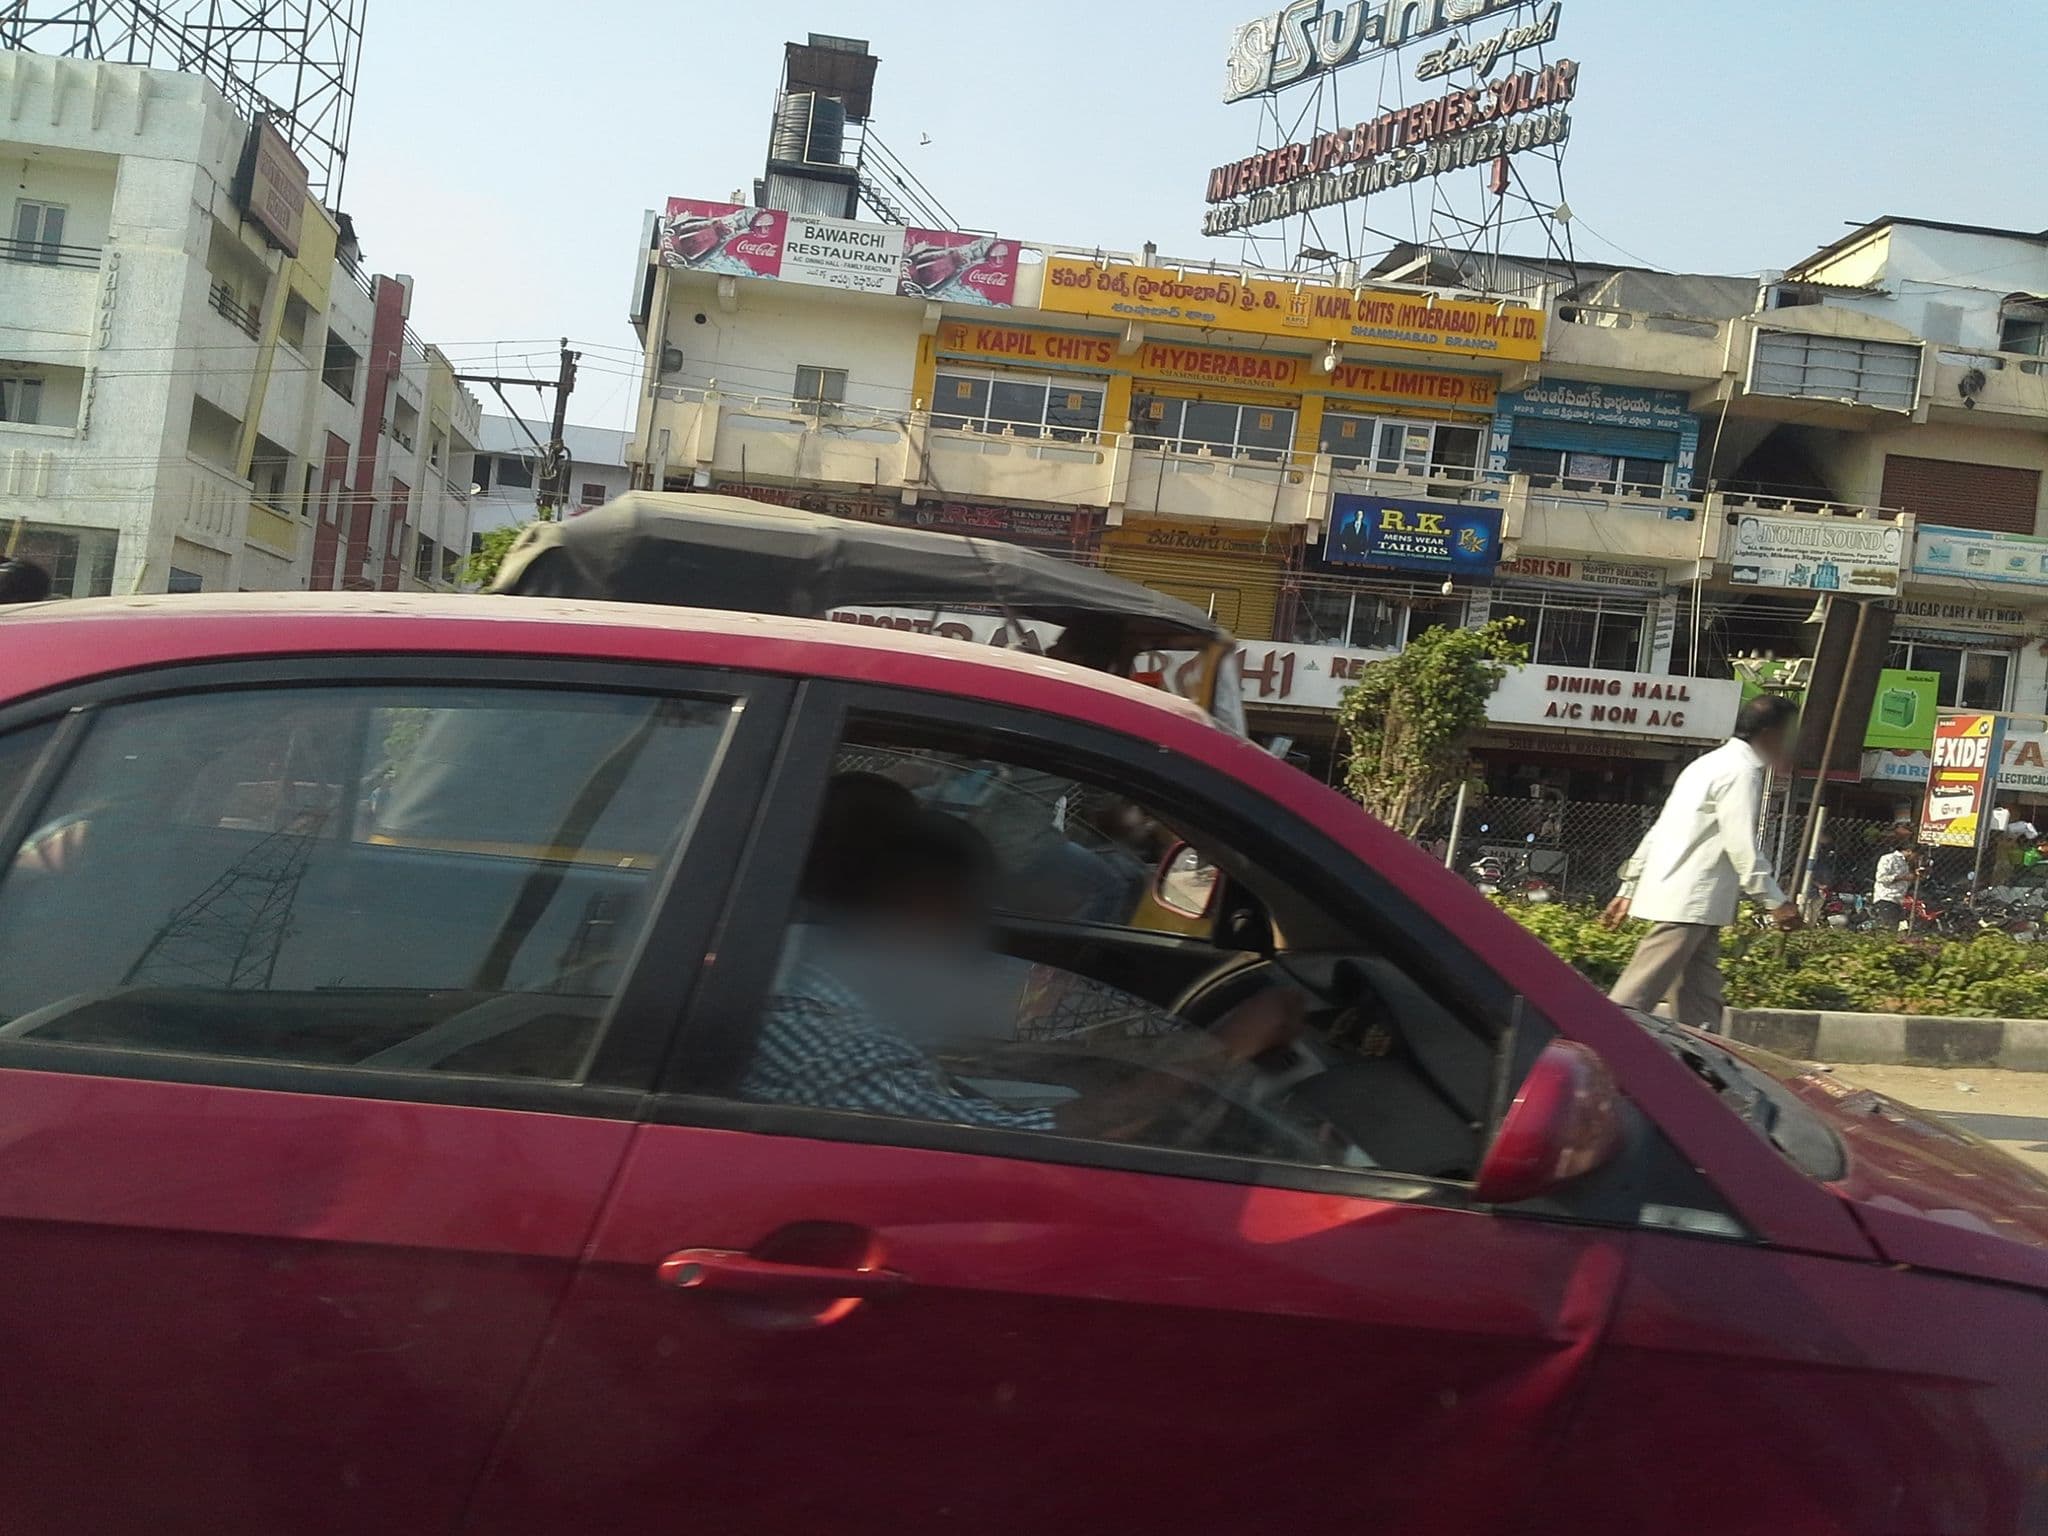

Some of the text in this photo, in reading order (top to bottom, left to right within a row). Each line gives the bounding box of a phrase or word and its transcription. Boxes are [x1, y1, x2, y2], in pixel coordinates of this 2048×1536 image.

[1201, 204, 1237, 237] SREE
[1294, 159, 1397, 213] MARKETING
[790, 216, 820, 225] AIRPORT
[804, 226, 885, 248] BAWARCHI
[787, 242, 899, 265] RESTAURANT
[805, 257, 824, 265] DINING
[843, 262, 863, 271] FAMILY
[1051, 268, 1094, 288] కపిల్
[1315, 295, 1537, 341] KAPIL CHITS (HYDERABAD) PVT. LTD.
[1351, 325, 1498, 350] SHAMSHABAD BRANCH
[976, 329, 1036, 355] KAPIL
[1045, 336, 1112, 363] CHITS
[1330, 364, 1376, 391] PVT.
[1380, 371, 1466, 399] LIMITED
[1233, 377, 1275, 388] BRANCH
[1043, 512, 1072, 522] WEAR
[1379, 508, 1452, 536] R.K.
[1378, 541, 1448, 556] TAILORS
[1384, 533, 1445, 546] MENS WEAR
[1757, 524, 1882, 551] JYOTHI SOUND
[1545, 562, 1571, 578] SAI
[1581, 574, 1598, 583] REAL
[1598, 576, 1619, 585] ESTATE
[1582, 565, 1615, 576] PROPERTY
[1546, 674, 1691, 702] DINING HALL
[1544, 701, 1685, 728] A/C NON A/C
[1933, 737, 1989, 767] EXIDE
